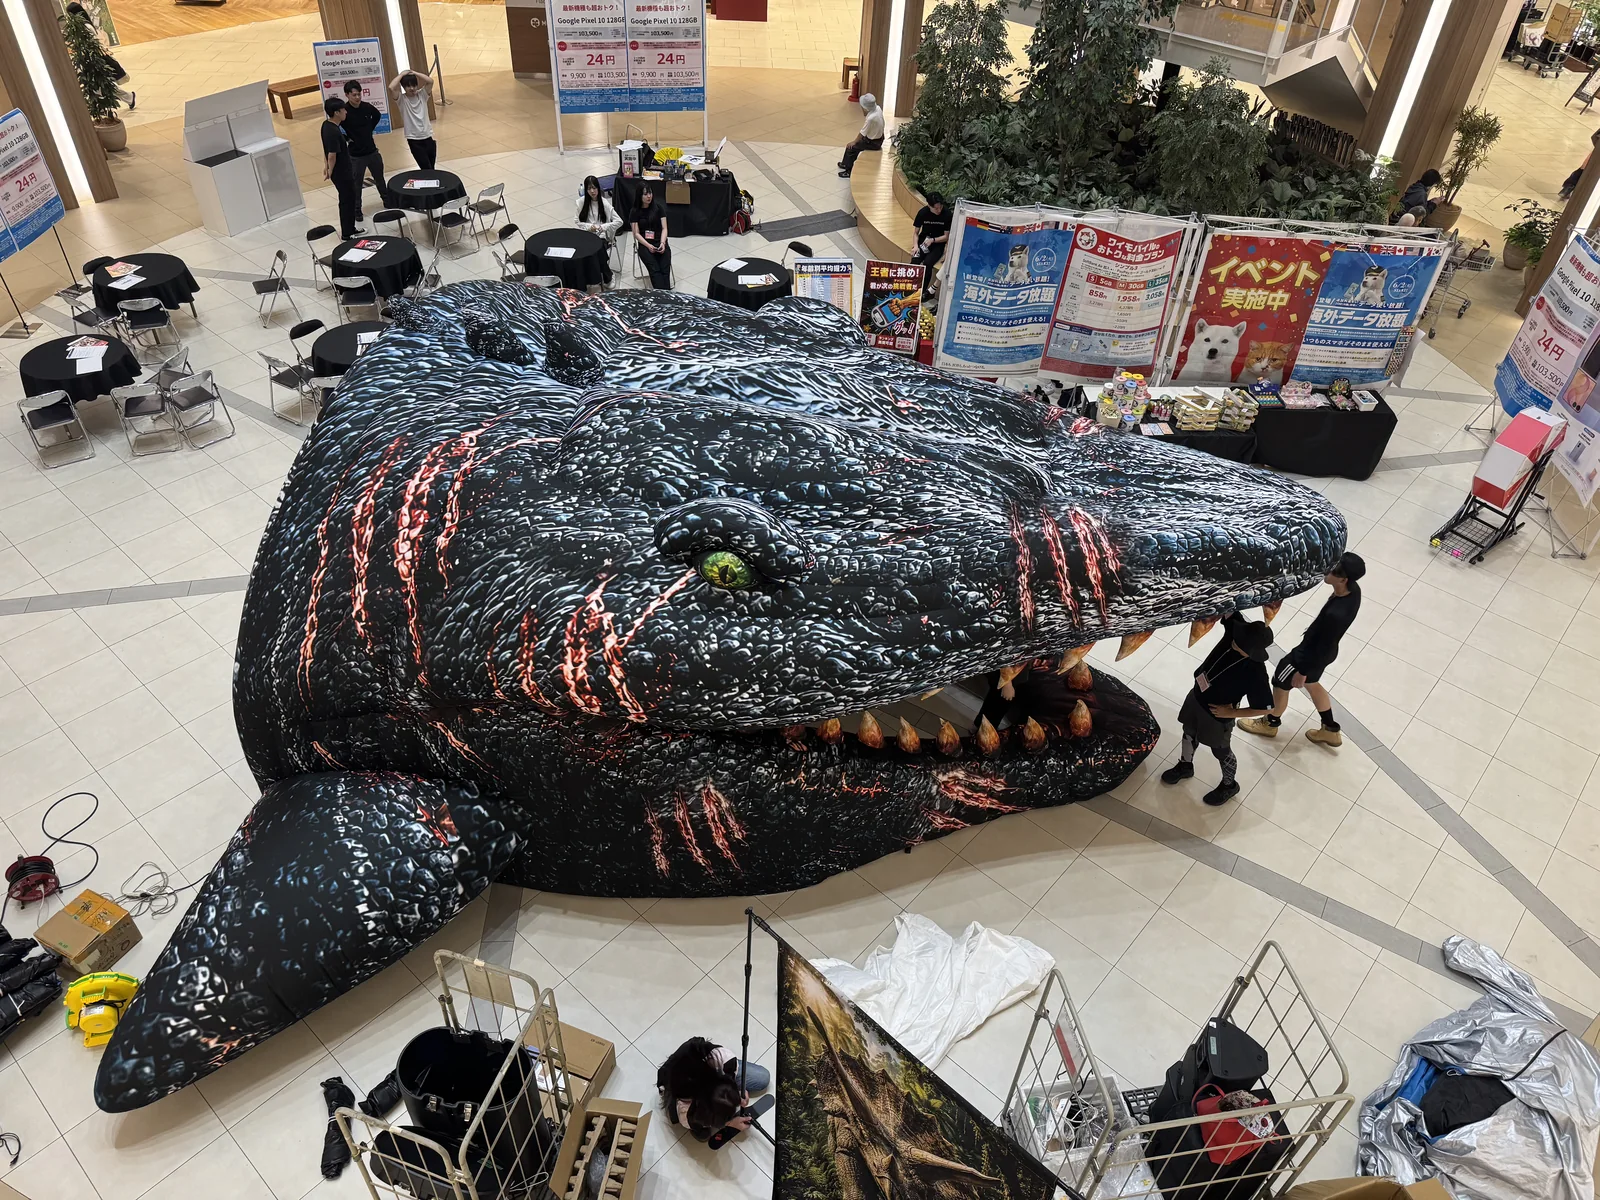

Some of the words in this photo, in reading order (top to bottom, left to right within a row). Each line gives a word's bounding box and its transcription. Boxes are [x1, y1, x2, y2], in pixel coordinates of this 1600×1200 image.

[557, 17, 580, 25] Google
[630, 17, 652, 26] Google
[586, 53, 615, 66] 24円
[657, 53, 685, 65] 24円
[15, 172, 38, 193] 24円
[1097, 244, 1165, 262] おトクな料金プラン
[1108, 237, 1160, 253] ワイモバイルの
[1208, 255, 1321, 288] イベント
[1569, 254, 1600, 288] 最新機種も超お
[962, 285, 1056, 306] 海外データ放題
[1220, 286, 1291, 311] 実施中
[1579, 291, 1591, 303] 10
[1590, 298, 1600, 312] 128
[961, 315, 1046, 326] いつものスマホがそのまま使える！
[1537, 328, 1565, 362] 24円
